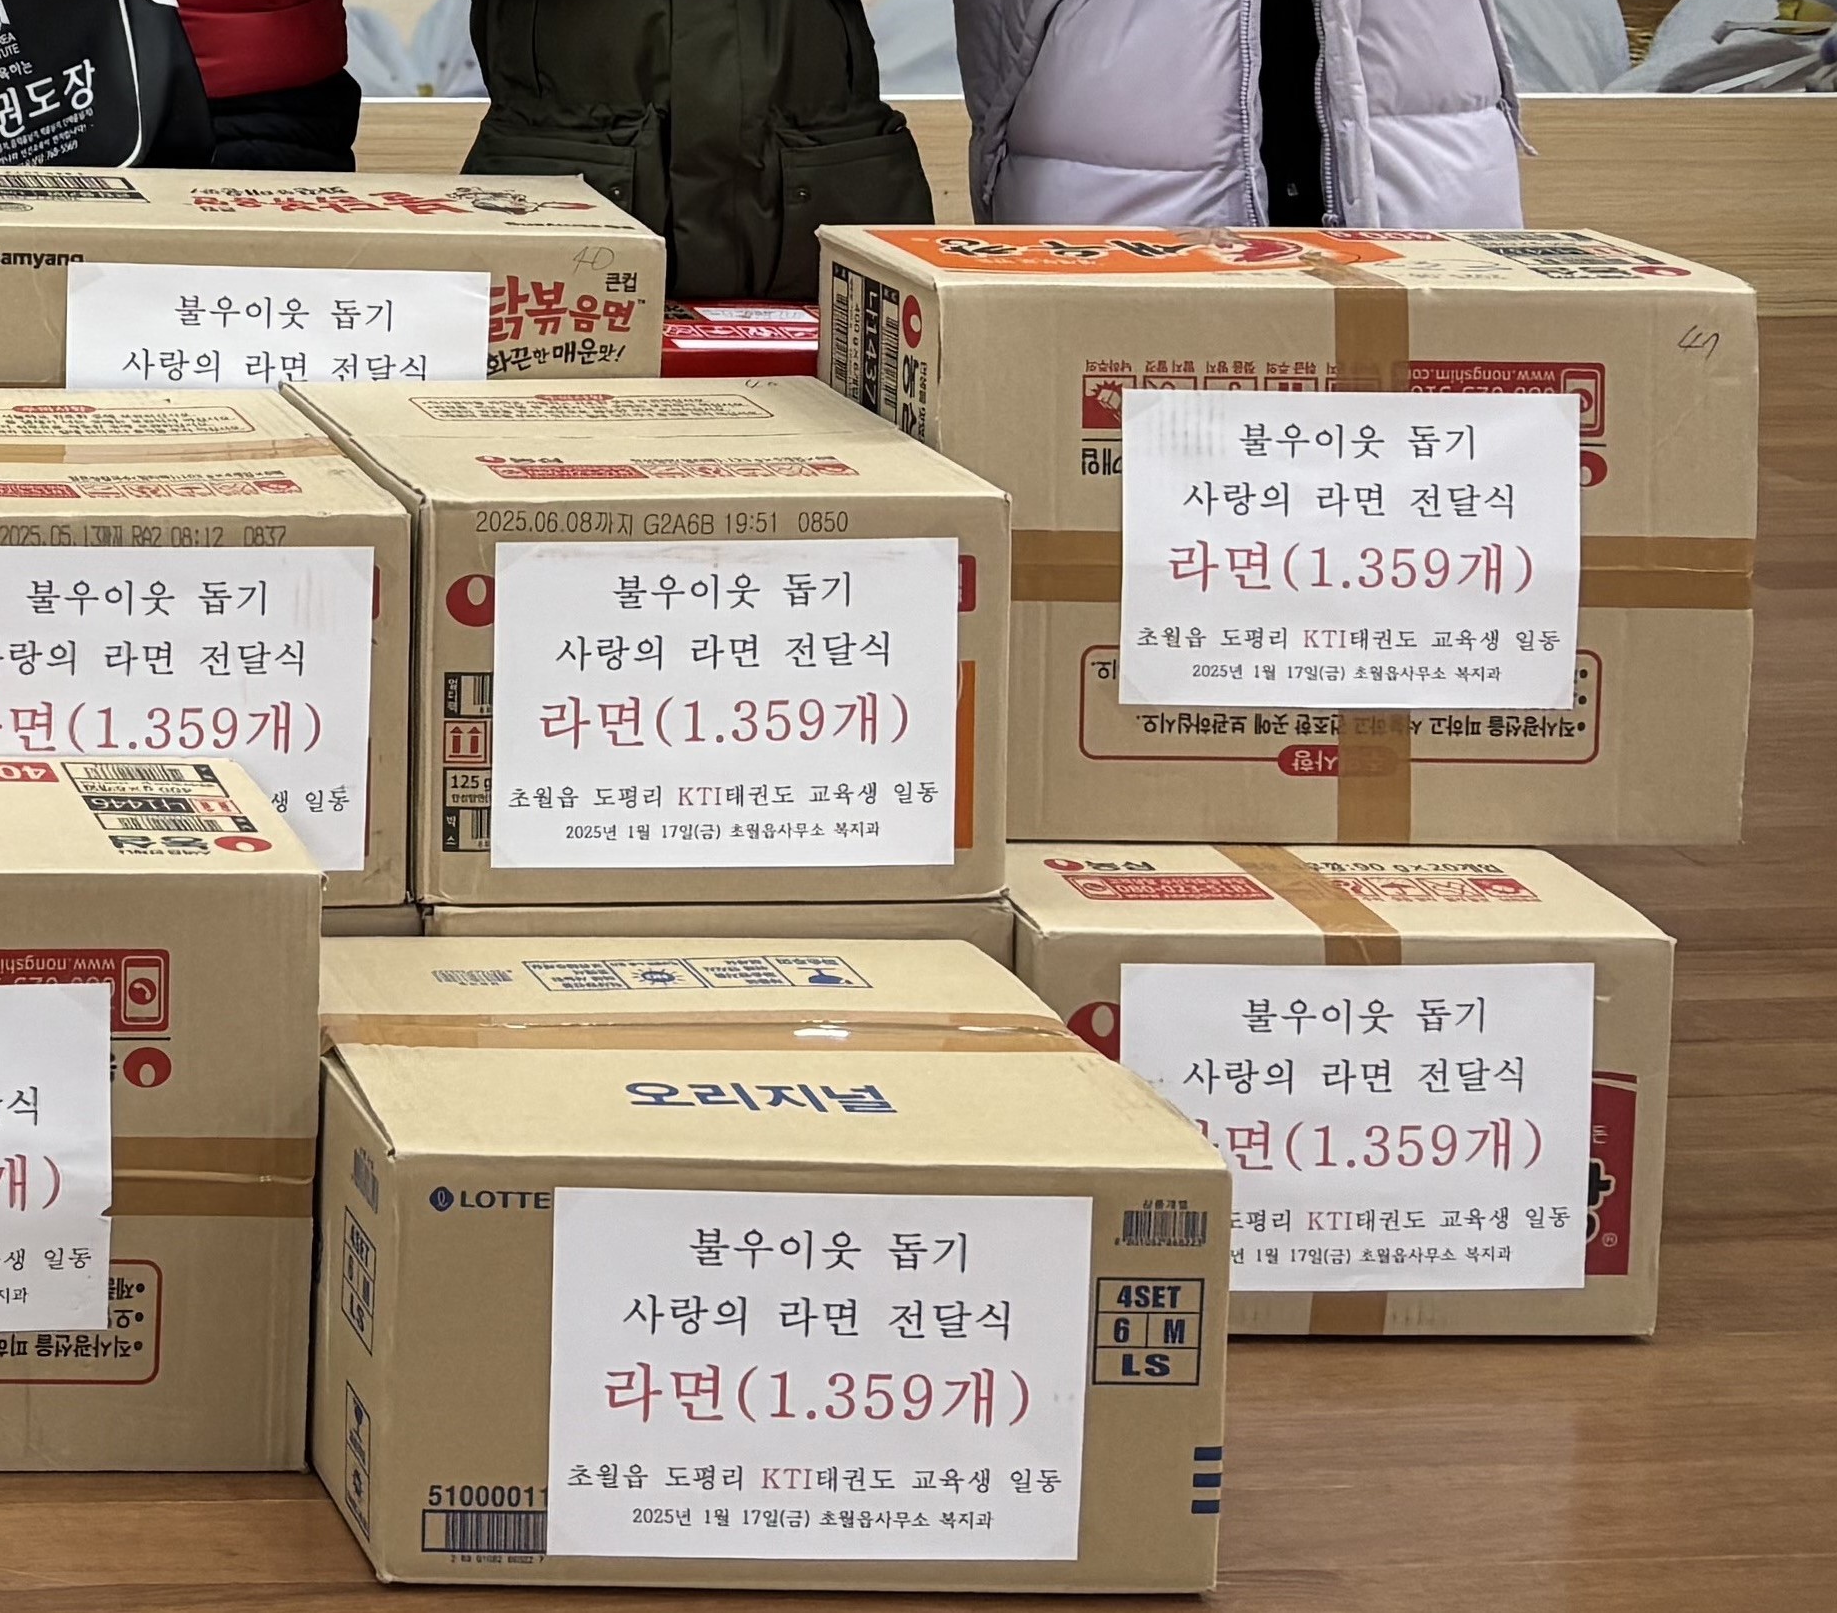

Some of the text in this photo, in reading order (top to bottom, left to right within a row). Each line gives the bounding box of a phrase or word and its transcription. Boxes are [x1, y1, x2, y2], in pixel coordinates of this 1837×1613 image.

[605, 272, 638, 293] 큰컵
[174, 295, 393, 332] 불우이웃 돕기
[1239, 422, 1474, 461] 불우이웃 돕기
[475, 510, 849, 537] 2025.06.08까지 G2A6B 19:51 0850
[1168, 539, 1533, 595] 라면(1.359개)
[539, 691, 908, 750] 라면(1.359개)
[450, 774, 481, 790] 125
[508, 781, 939, 809] 초월읍 도평리 KTI태권도 교육생 일동
[108, 835, 210, 851] 농심
[1241, 996, 1485, 1036] 불우이웃 돕기
[625, 1080, 898, 1114] 오리지널
[459, 1190, 551, 1210] LOTTE
[1116, 1283, 1183, 1309] 4SET
[1112, 1318, 1186, 1344] 6 M
[34, 1334, 132, 1359] 직사광선을
[1121, 1352, 1171, 1377] LS
[604, 1361, 1029, 1429] 라면(1.359개)
[632, 1507, 994, 1530] 2025년 1월 17일(금) 초월읍사무소 복지과
